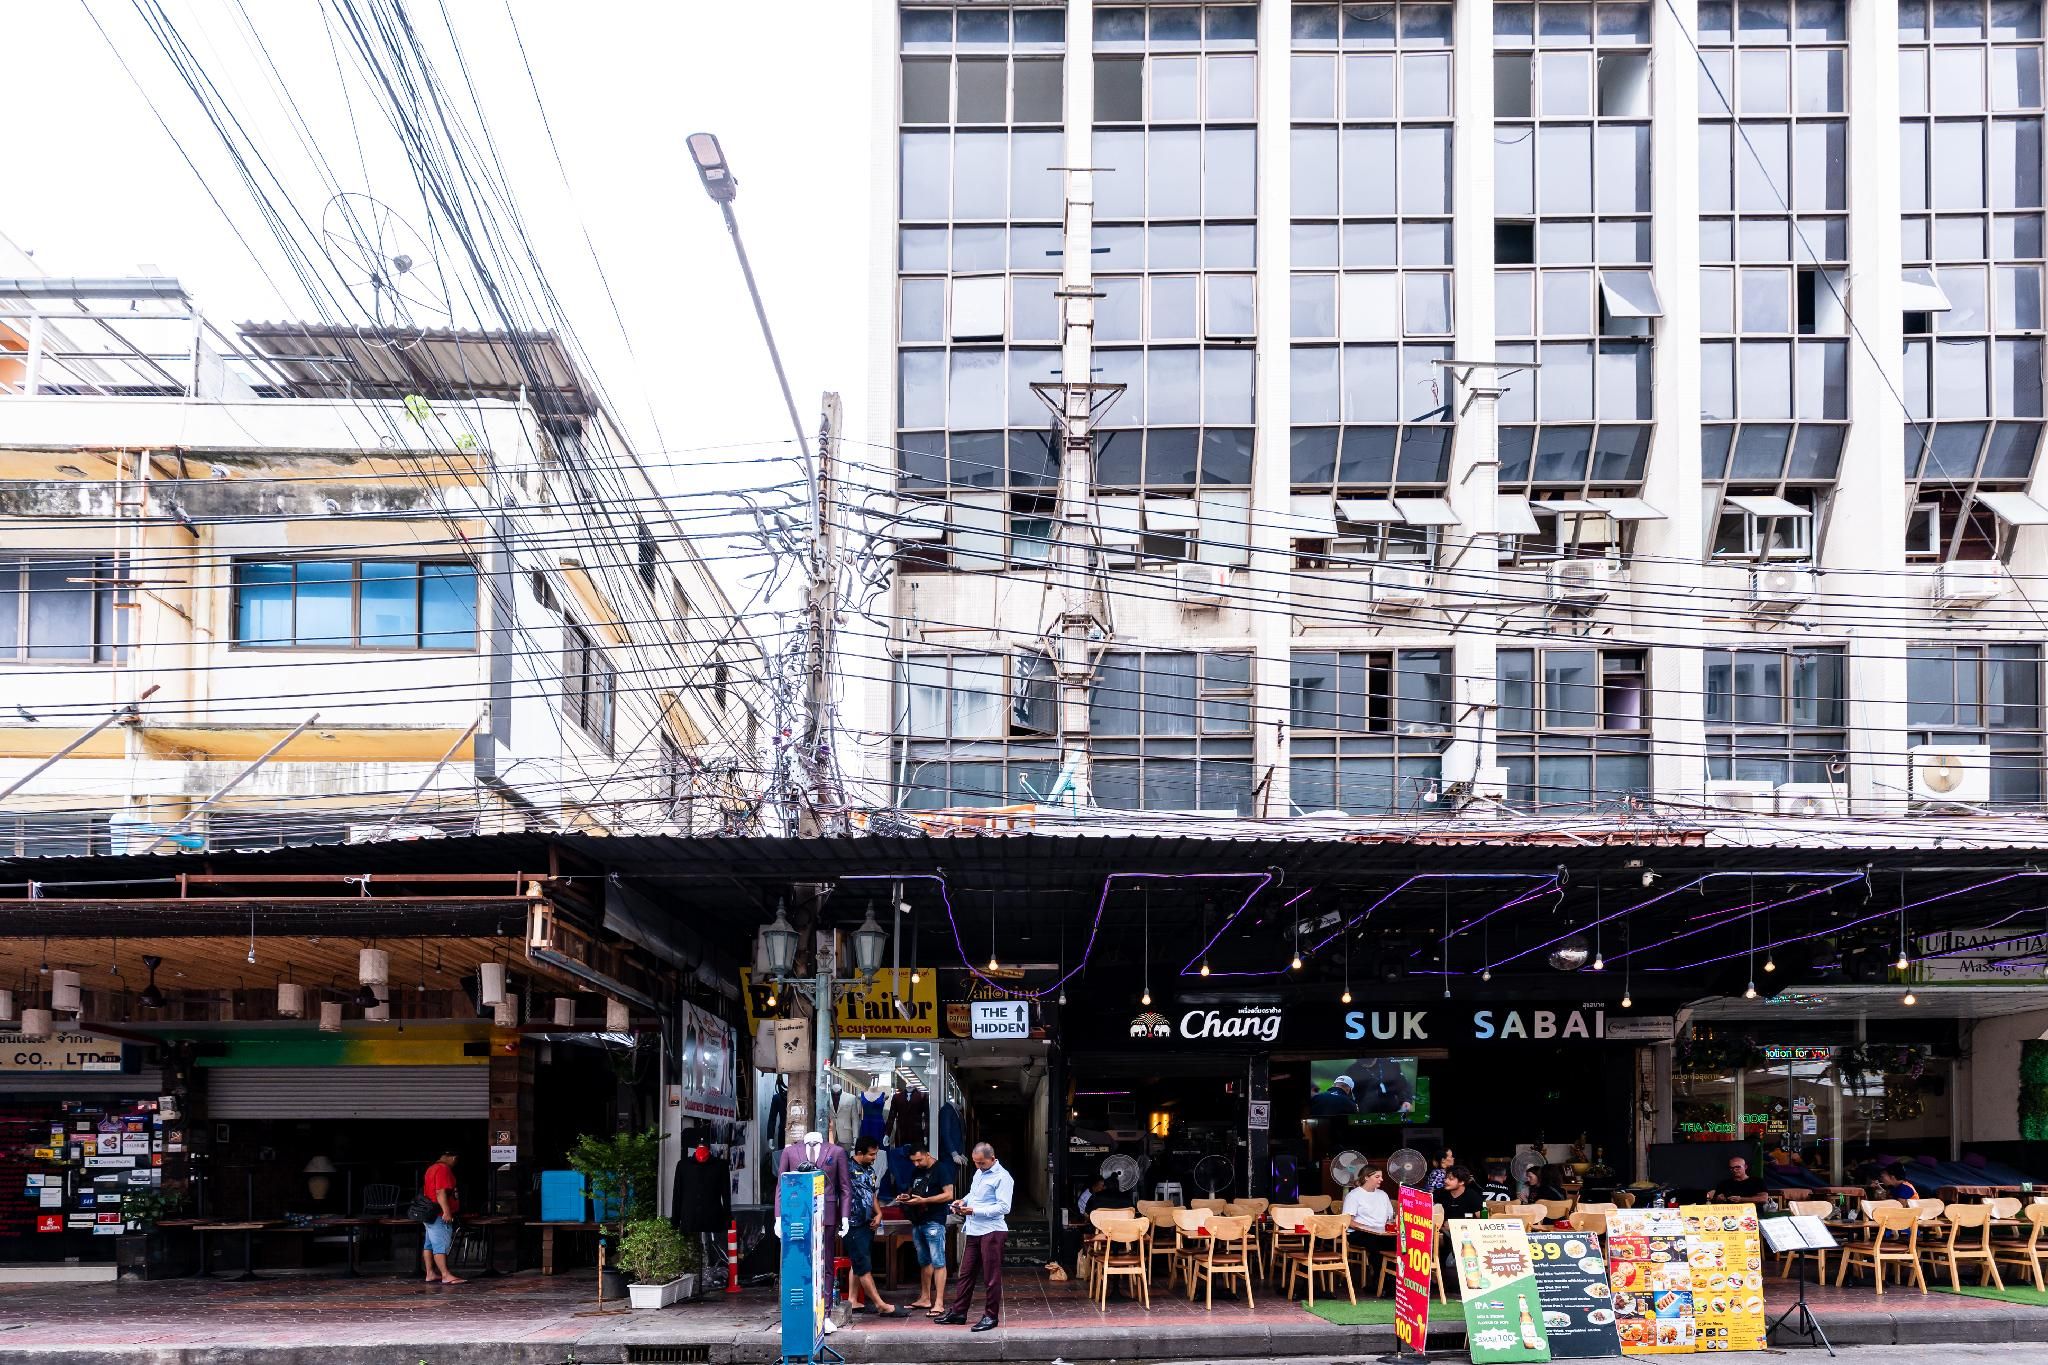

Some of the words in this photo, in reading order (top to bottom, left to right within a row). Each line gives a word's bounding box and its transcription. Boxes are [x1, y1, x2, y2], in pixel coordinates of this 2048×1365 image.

[1960, 960, 2017, 976] Massage
[843, 991, 933, 1020] Tailor
[981, 1007, 1008, 1017] THE
[847, 1025, 892, 1034] CUSTOM
[896, 1025, 932, 1034] TAILOR
[974, 1023, 1026, 1033] HIDDEN
[1180, 1010, 1282, 1041] Chang
[1345, 1011, 1428, 1040] SUK
[1473, 1011, 1604, 1039] SABAI
[14, 1052, 52, 1065] CO.,
[1795, 1048, 1809, 1058] for
[1811, 1049, 1829, 1060] you
[1400, 1187, 1415, 1198] SPECIAL
[1403, 1211, 1413, 1225] BIG
[1410, 1228, 1425, 1243] BEER
[1529, 1242, 1561, 1260] 89
[1408, 1247, 1431, 1276] 100
[1475, 1301, 1490, 1310] IPA
[1395, 1317, 1412, 1344] 100
